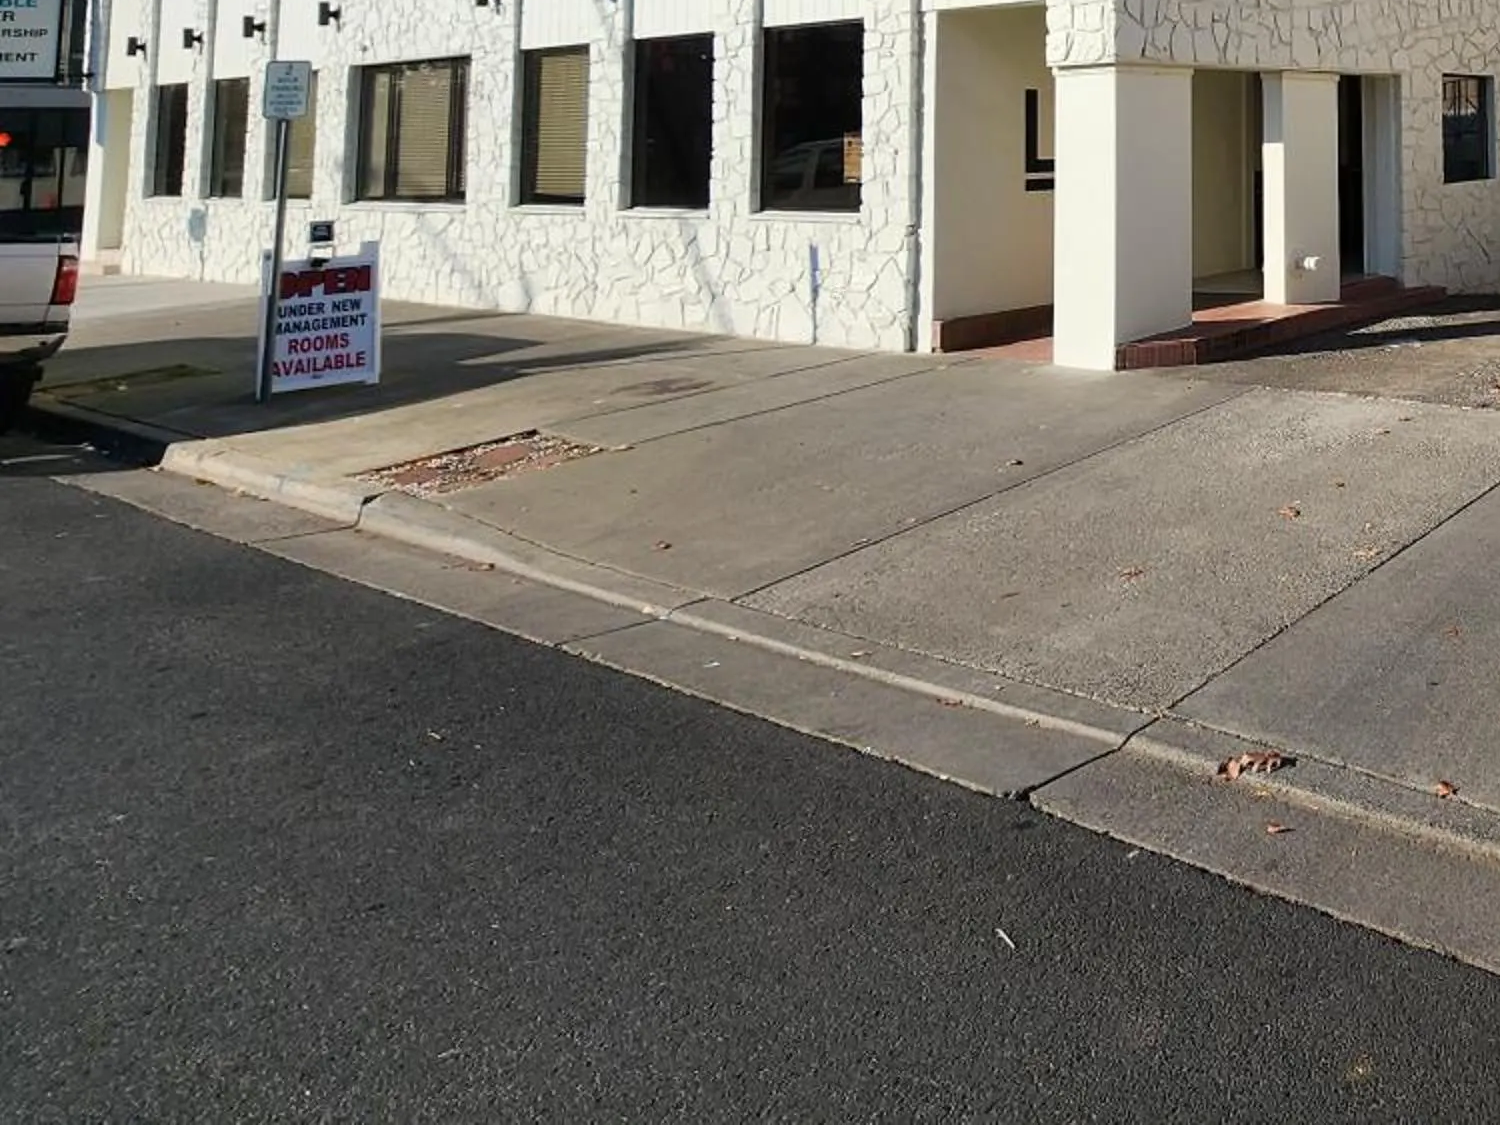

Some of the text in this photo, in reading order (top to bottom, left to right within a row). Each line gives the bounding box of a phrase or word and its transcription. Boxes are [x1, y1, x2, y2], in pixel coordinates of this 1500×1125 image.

[278, 298, 362, 319] UNDER NEW
[288, 333, 350, 355] ROOMS
